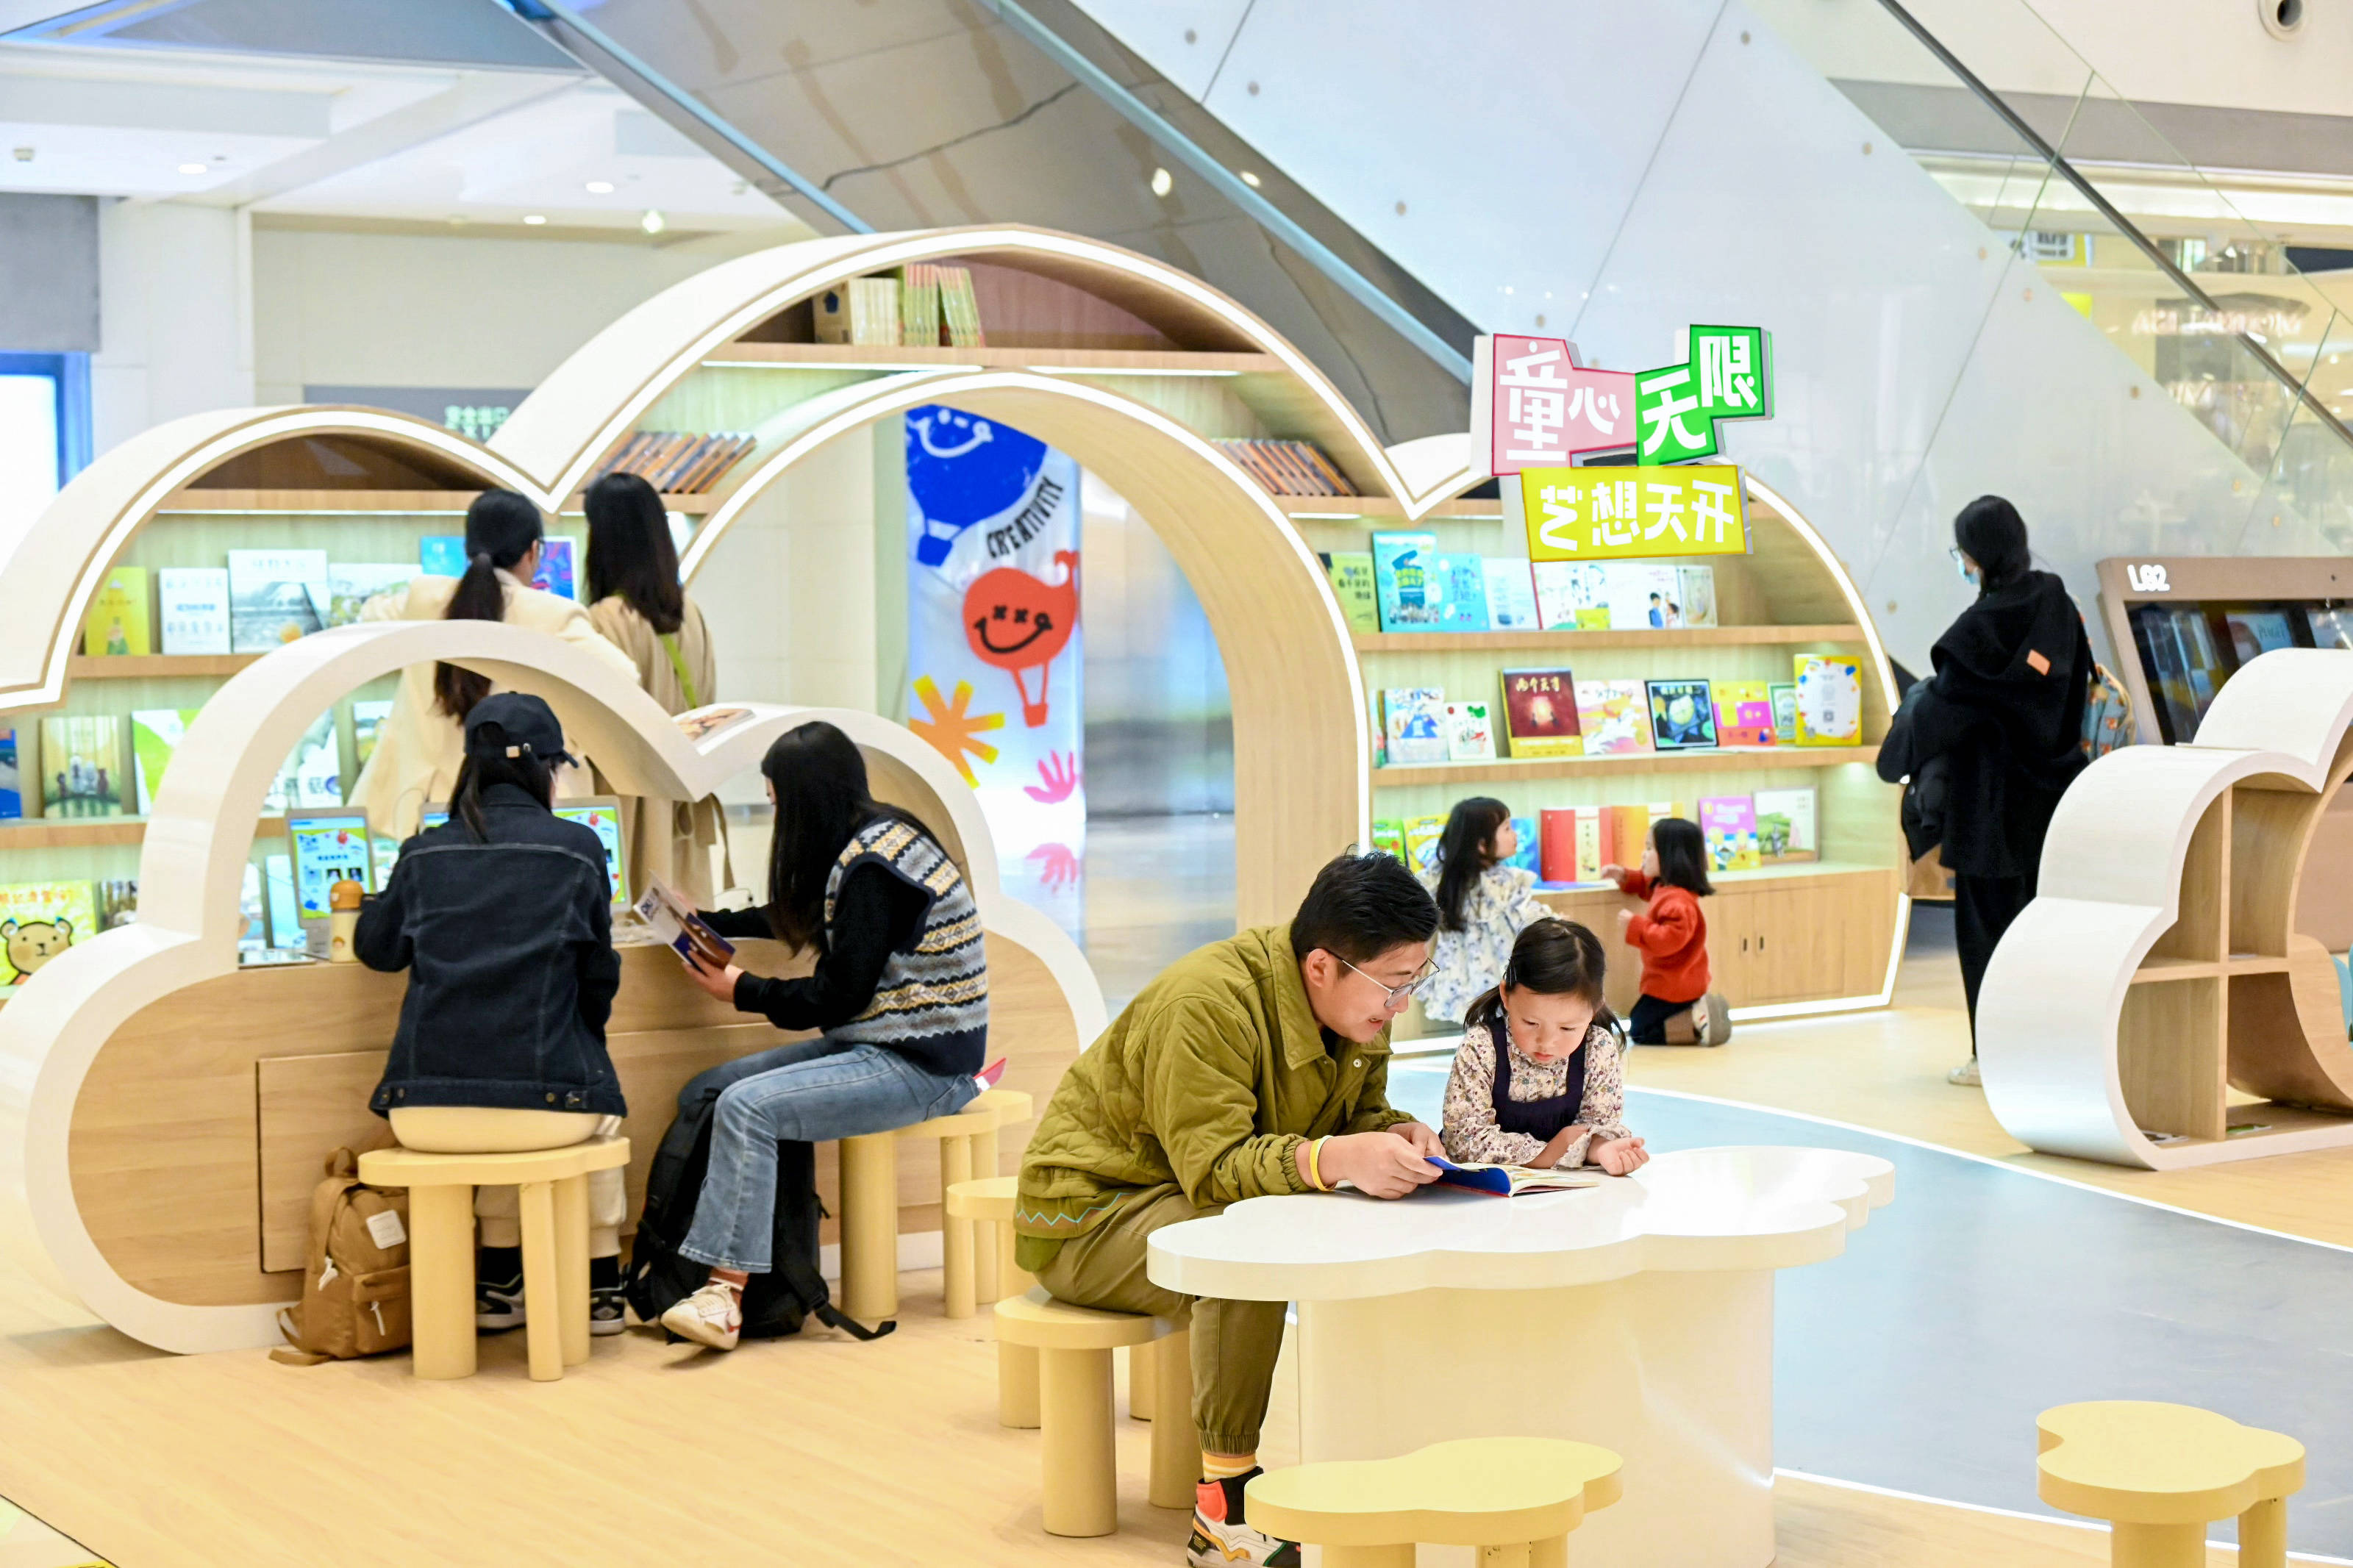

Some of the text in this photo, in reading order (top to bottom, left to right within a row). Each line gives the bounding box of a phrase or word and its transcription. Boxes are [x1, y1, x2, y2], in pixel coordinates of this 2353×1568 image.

[987, 476, 1064, 559] CREATIVITY
[1540, 480, 1735, 552] 艺想天开
